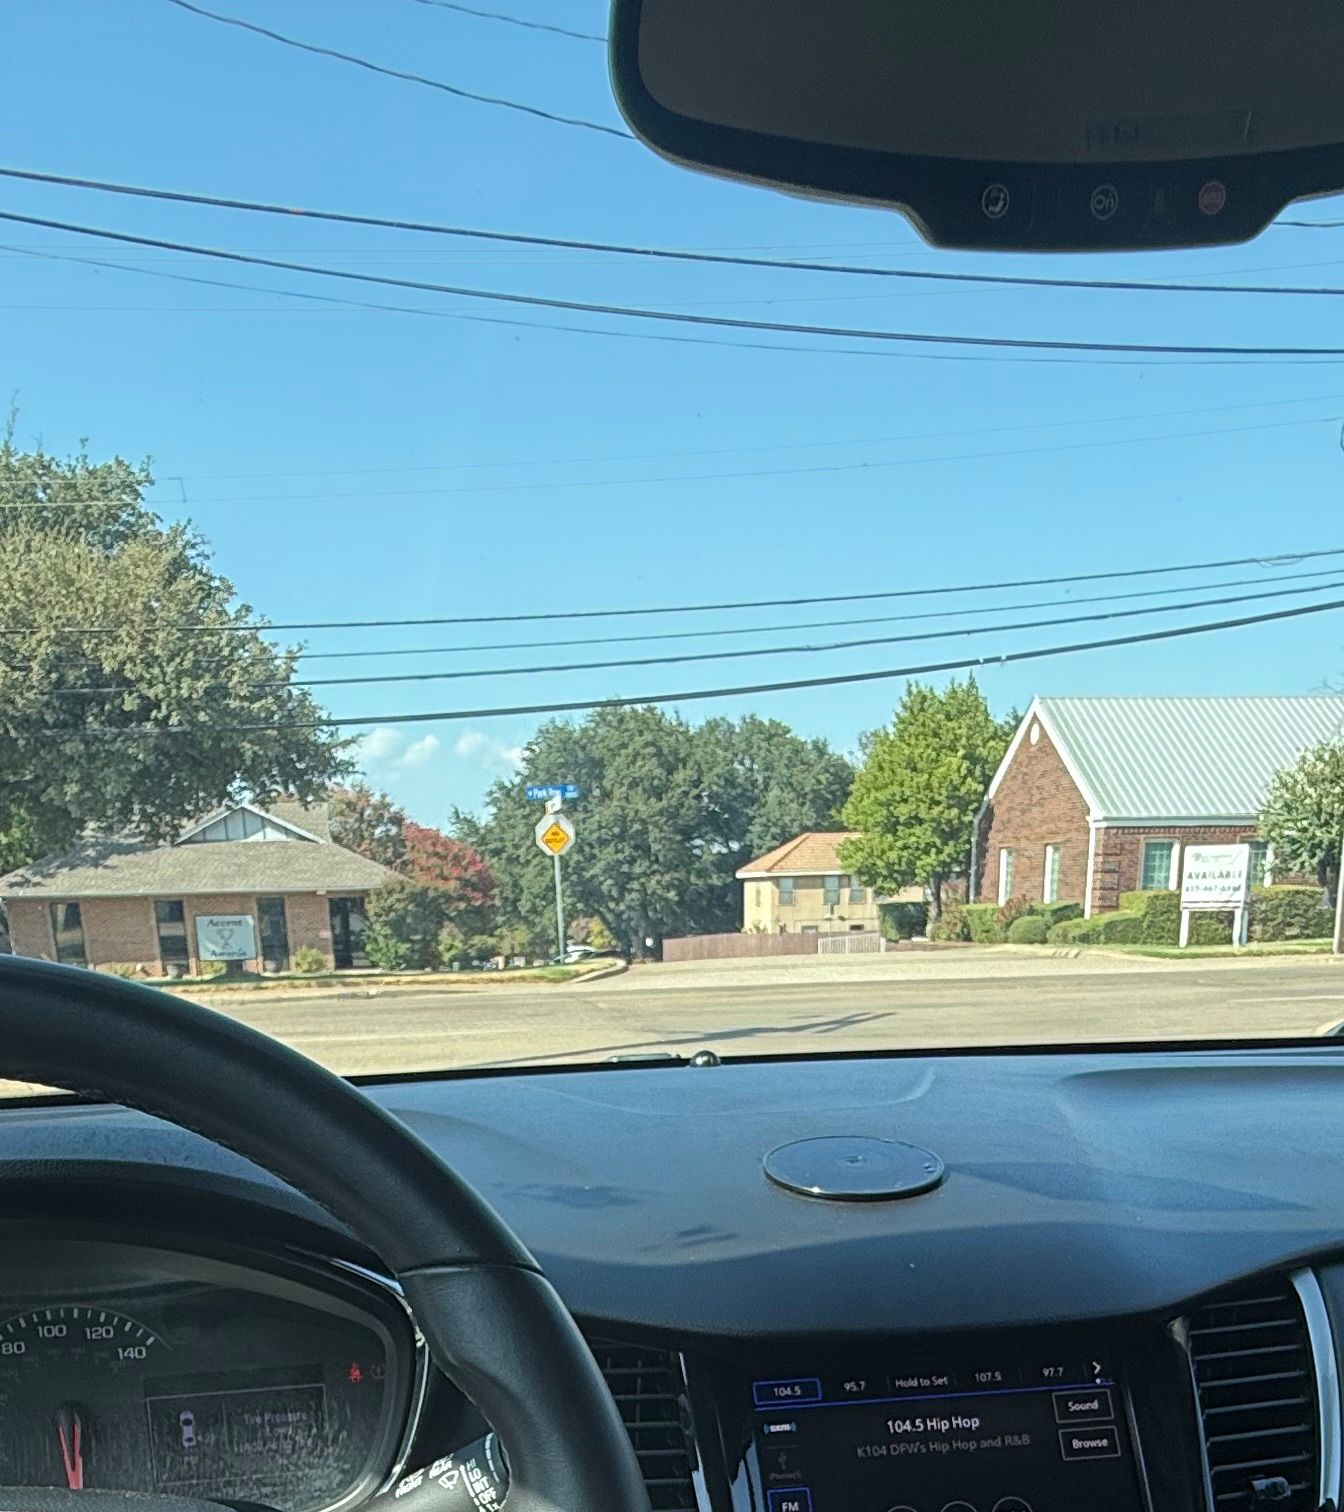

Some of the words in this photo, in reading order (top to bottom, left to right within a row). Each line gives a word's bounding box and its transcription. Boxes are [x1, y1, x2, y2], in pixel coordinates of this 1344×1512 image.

[37, 1324, 67, 1338] 100
[85, 1325, 114, 1339] 120
[1, 1341, 26, 1355] 80
[117, 1346, 146, 1360] 140
[974, 1371, 1003, 1384] 107.5
[1043, 1366, 1065, 1378] 97.7
[843, 1379, 867, 1393] 95.7
[895, 1377, 918, 1389] Hold
[920, 1377, 931, 1388] to
[932, 1376, 949, 1387] Set
[772, 1385, 802, 1398] 104.5
[1067, 1399, 1100, 1413] Sound
[887, 1418, 924, 1435] 104.5
[926, 1417, 950, 1434] Hip
[951, 1415, 980, 1433] Hop
[856, 1444, 888, 1458] K104
[889, 1441, 926, 1457] DFW's
[929, 1439, 950, 1455] Hip
[952, 1438, 978, 1454] Hop
[979, 1436, 1002, 1450] and
[1004, 1433, 1031, 1447] R&B
[1071, 1436, 1109, 1450] Browse
[781, 1501, 800, 1512] FM
